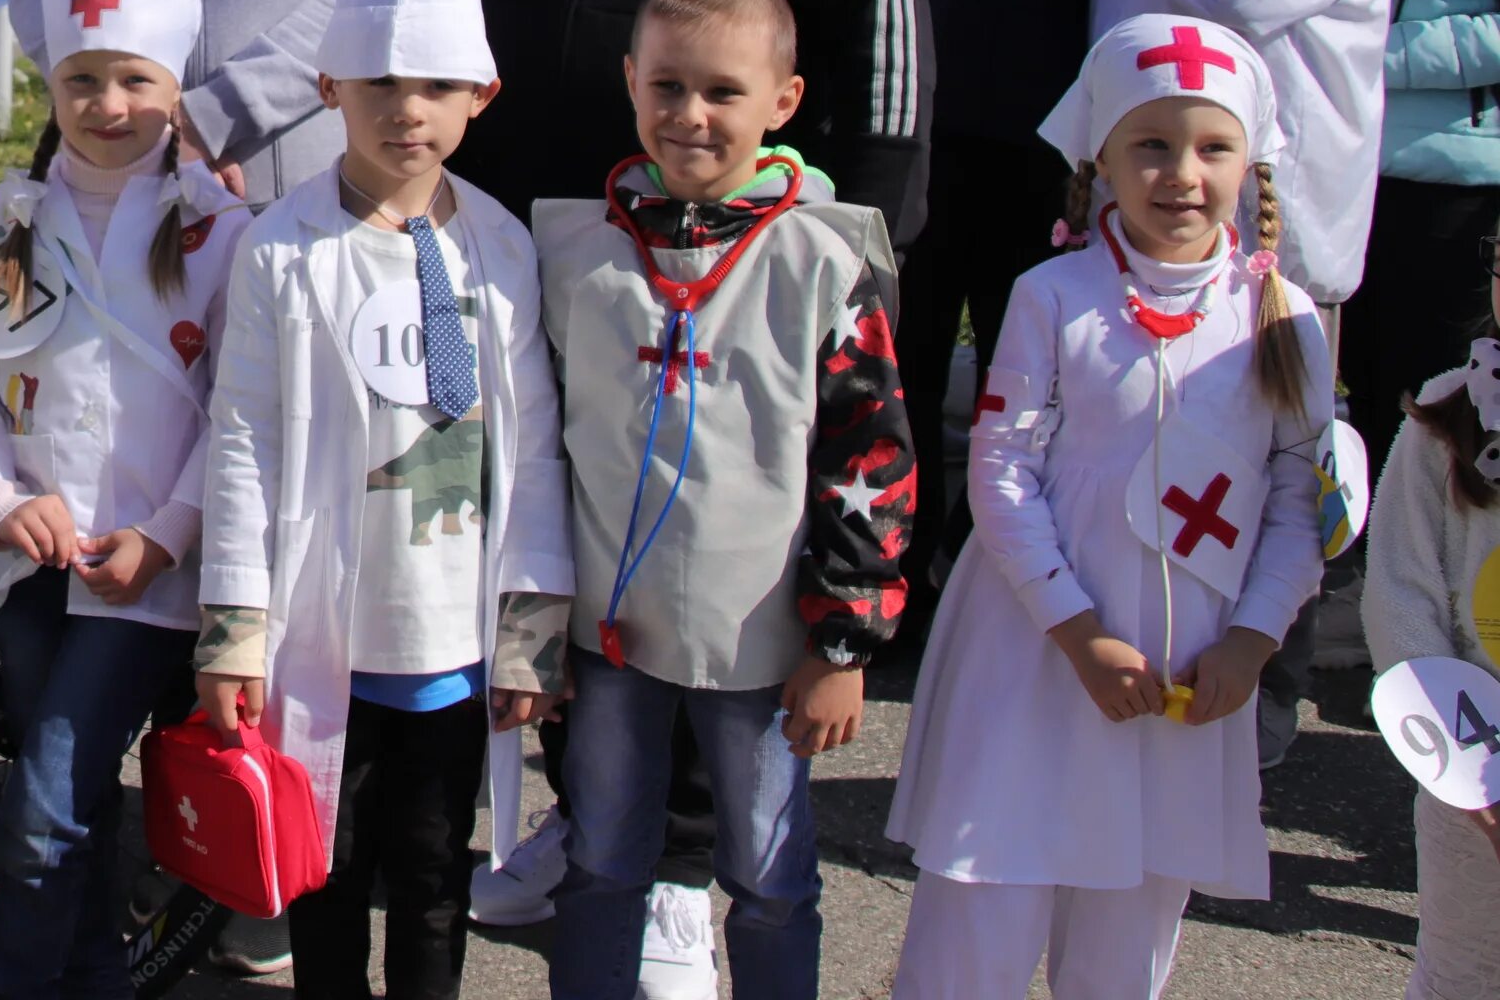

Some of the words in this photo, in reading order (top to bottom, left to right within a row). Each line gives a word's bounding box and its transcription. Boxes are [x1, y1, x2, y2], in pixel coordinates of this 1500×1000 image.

[373, 323, 426, 368] 10
[1400, 689, 1500, 783] 94
[130, 898, 218, 989] TCHINSON
